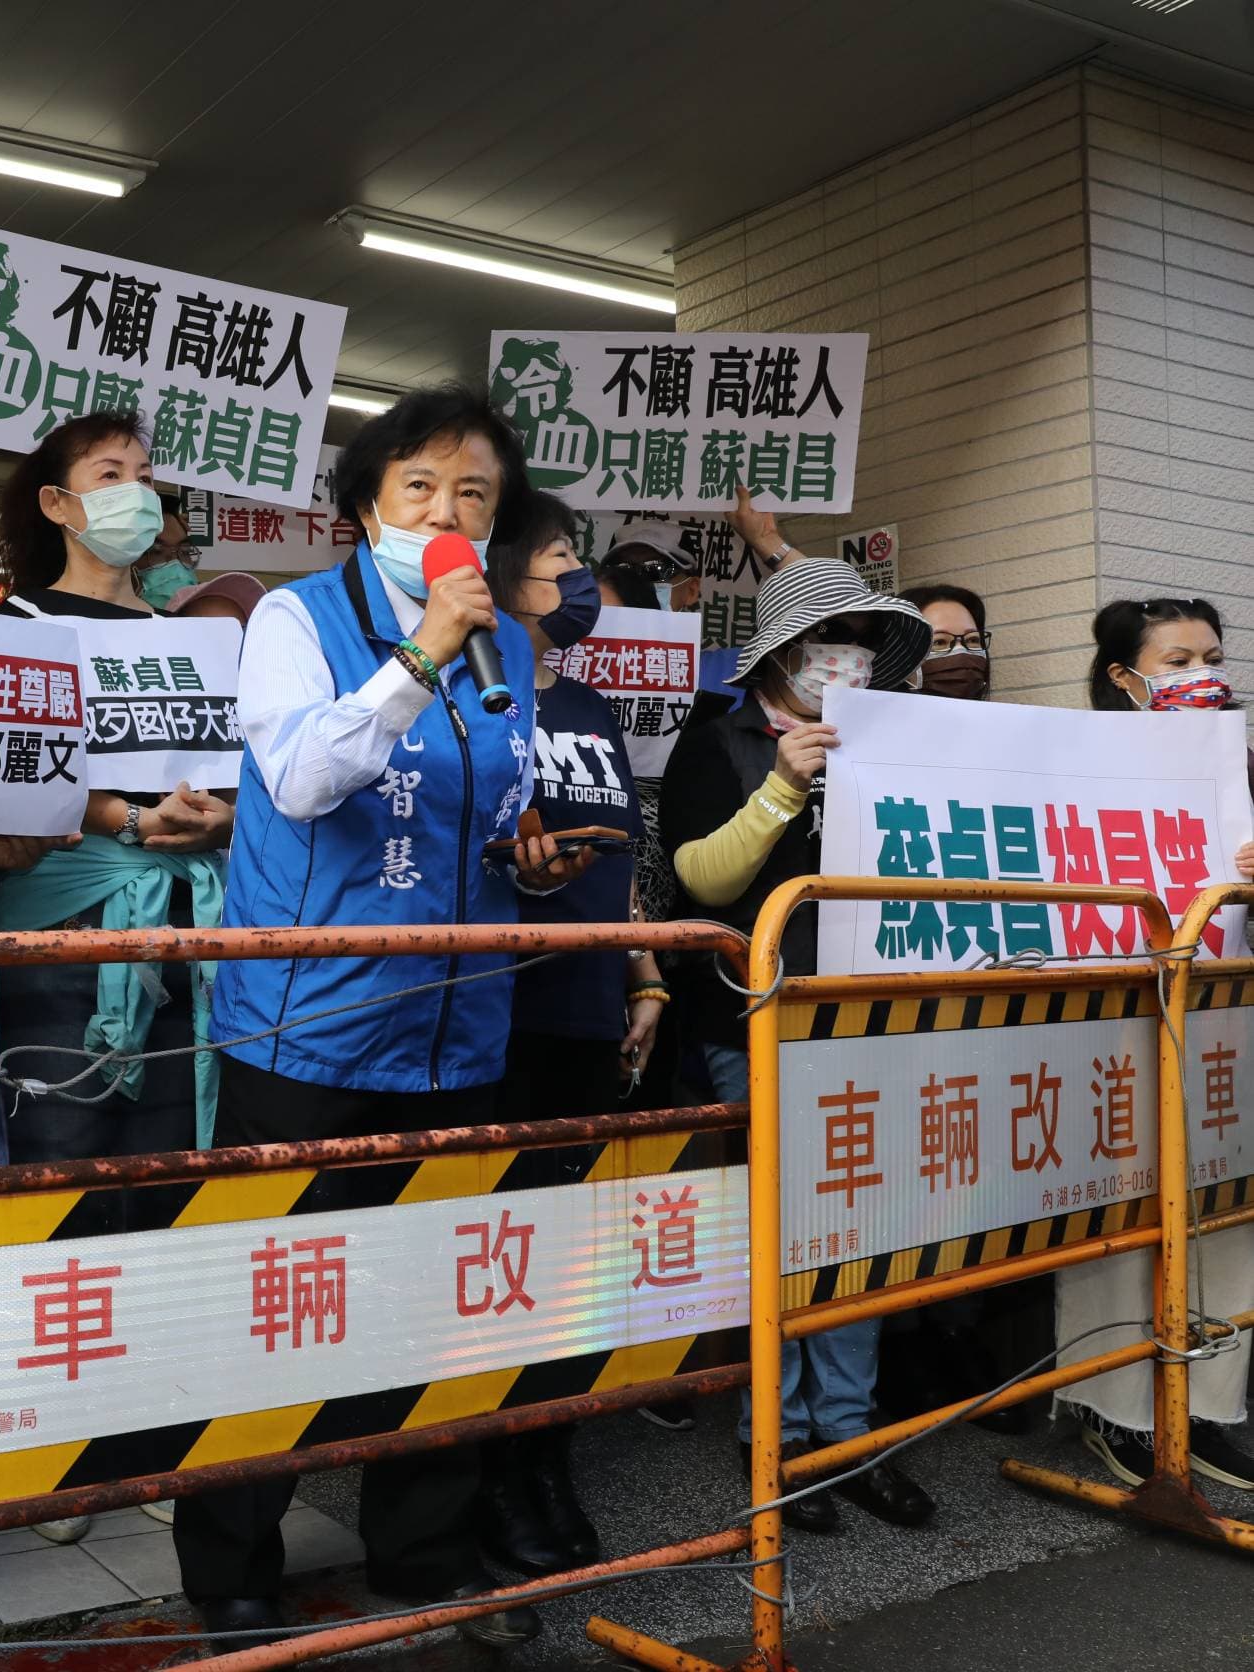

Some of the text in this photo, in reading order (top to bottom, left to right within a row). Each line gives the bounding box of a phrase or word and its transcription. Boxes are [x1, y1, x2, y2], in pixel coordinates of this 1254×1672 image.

[165, 292, 314, 399] 高雄人
[706, 345, 844, 419] 高雄人
[149, 384, 303, 493] 蘇貞昌
[698, 427, 837, 502] 蘇貞昌
[218, 507, 285, 544] 道歉
[90, 656, 205, 693] 蘇貞昌
[533, 726, 622, 790] MT
[565, 784, 628, 809] TOGETHER
[1202, 1041, 1239, 1142] 車
[816, 1053, 1138, 1209] 車輛改道
[17, 1185, 704, 1382] 車輛改道
